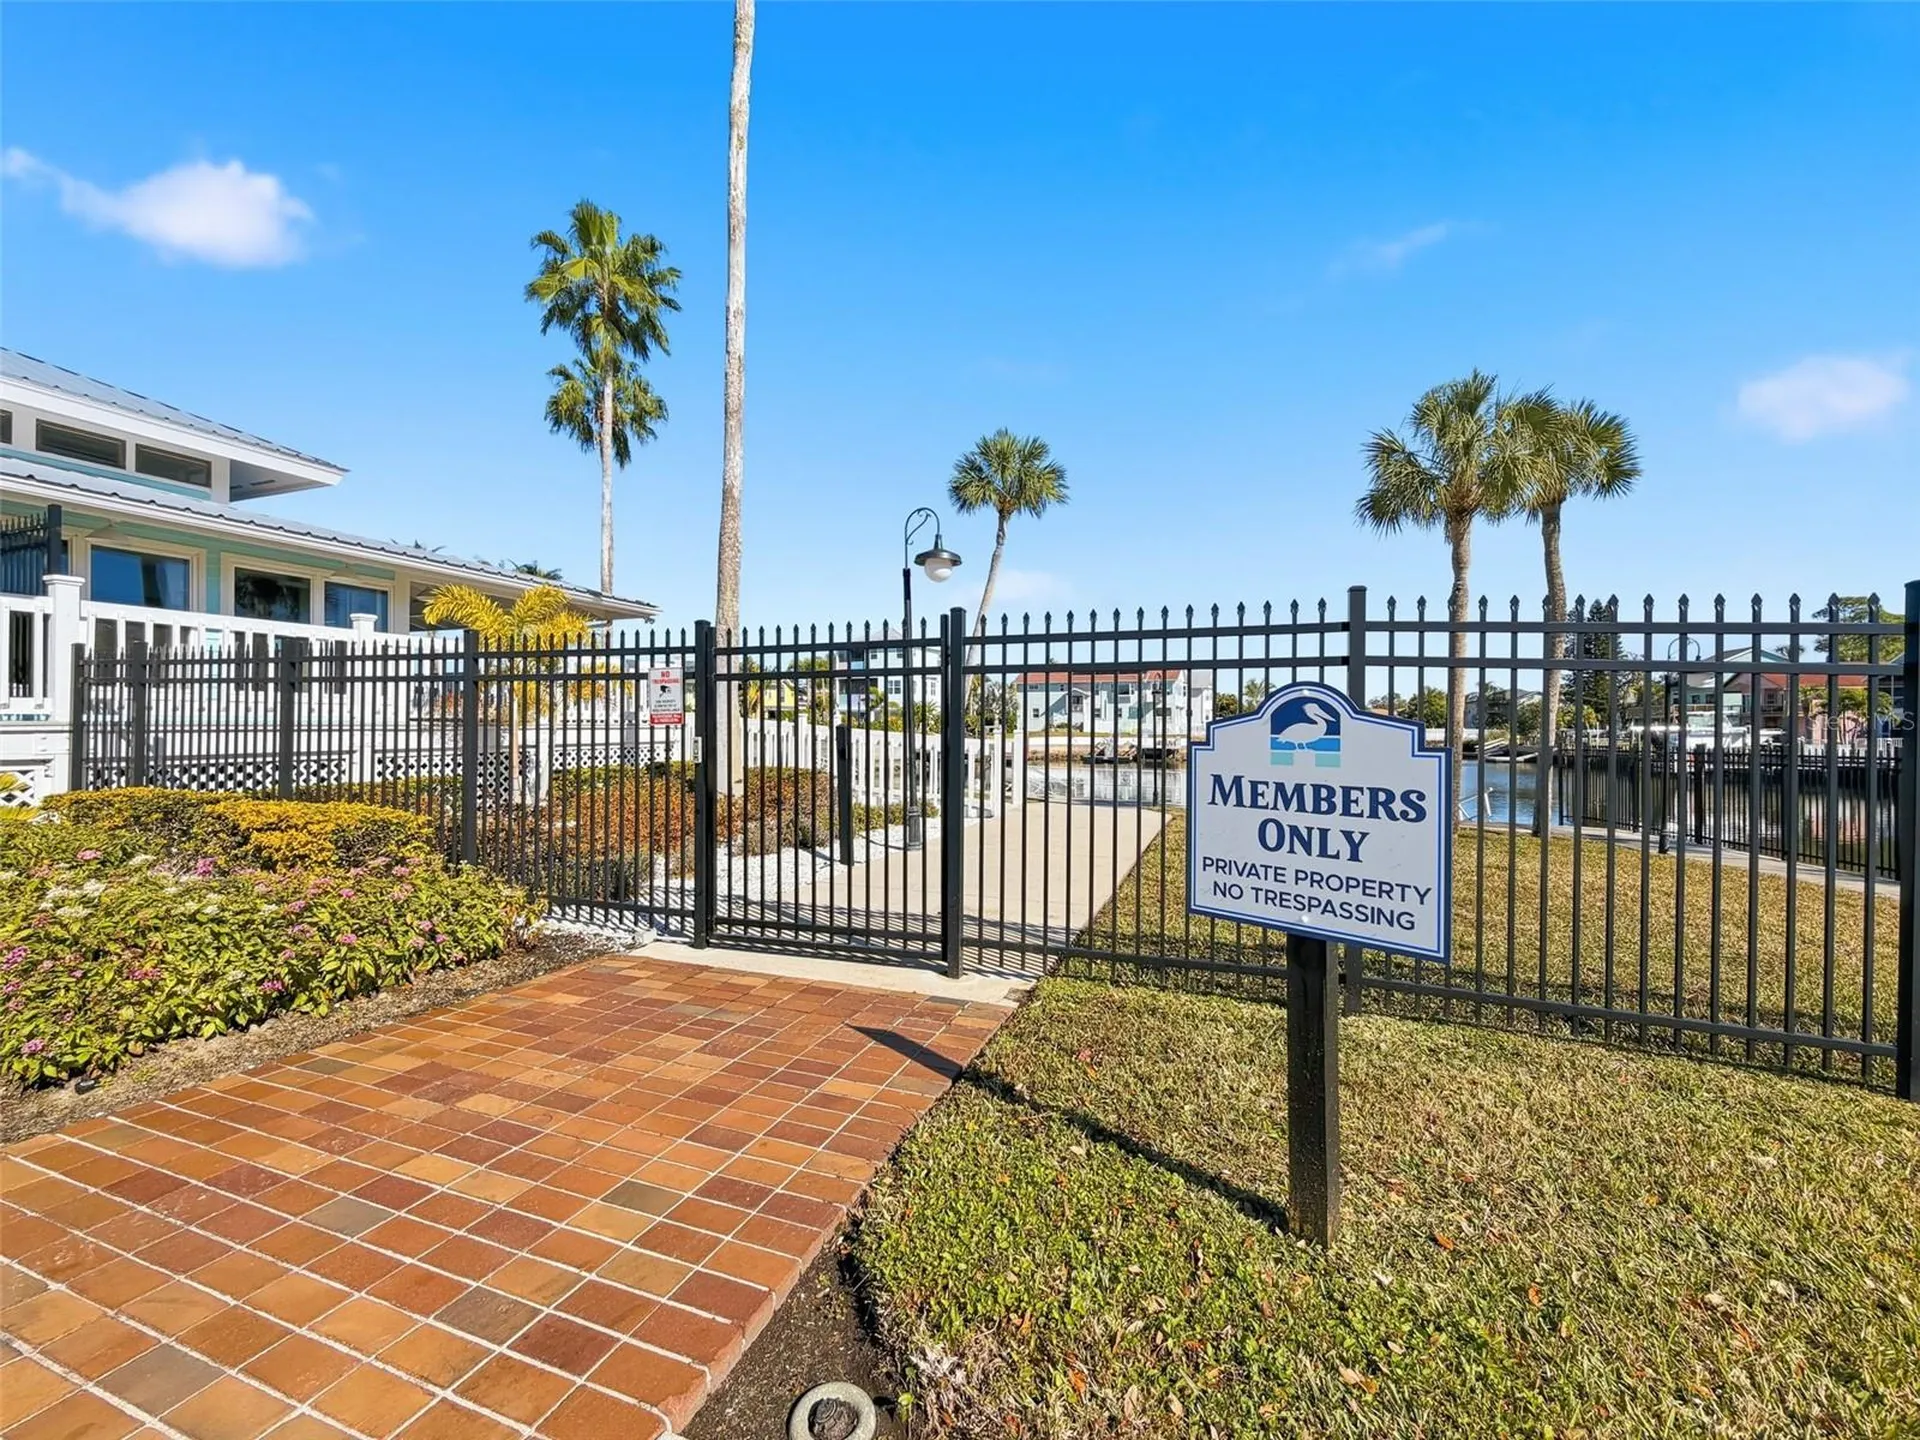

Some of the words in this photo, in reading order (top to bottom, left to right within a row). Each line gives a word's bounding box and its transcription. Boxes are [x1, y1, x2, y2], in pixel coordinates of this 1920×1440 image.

[1207, 773, 1427, 823] MEMBERS
[1258, 817, 1370, 863] ONLY
[1202, 856, 1287, 884] PRIVATE
[1294, 869, 1432, 906] PROPERTY
[1213, 880, 1244, 900] NO
[1250, 886, 1416, 931] TRESPASSING
